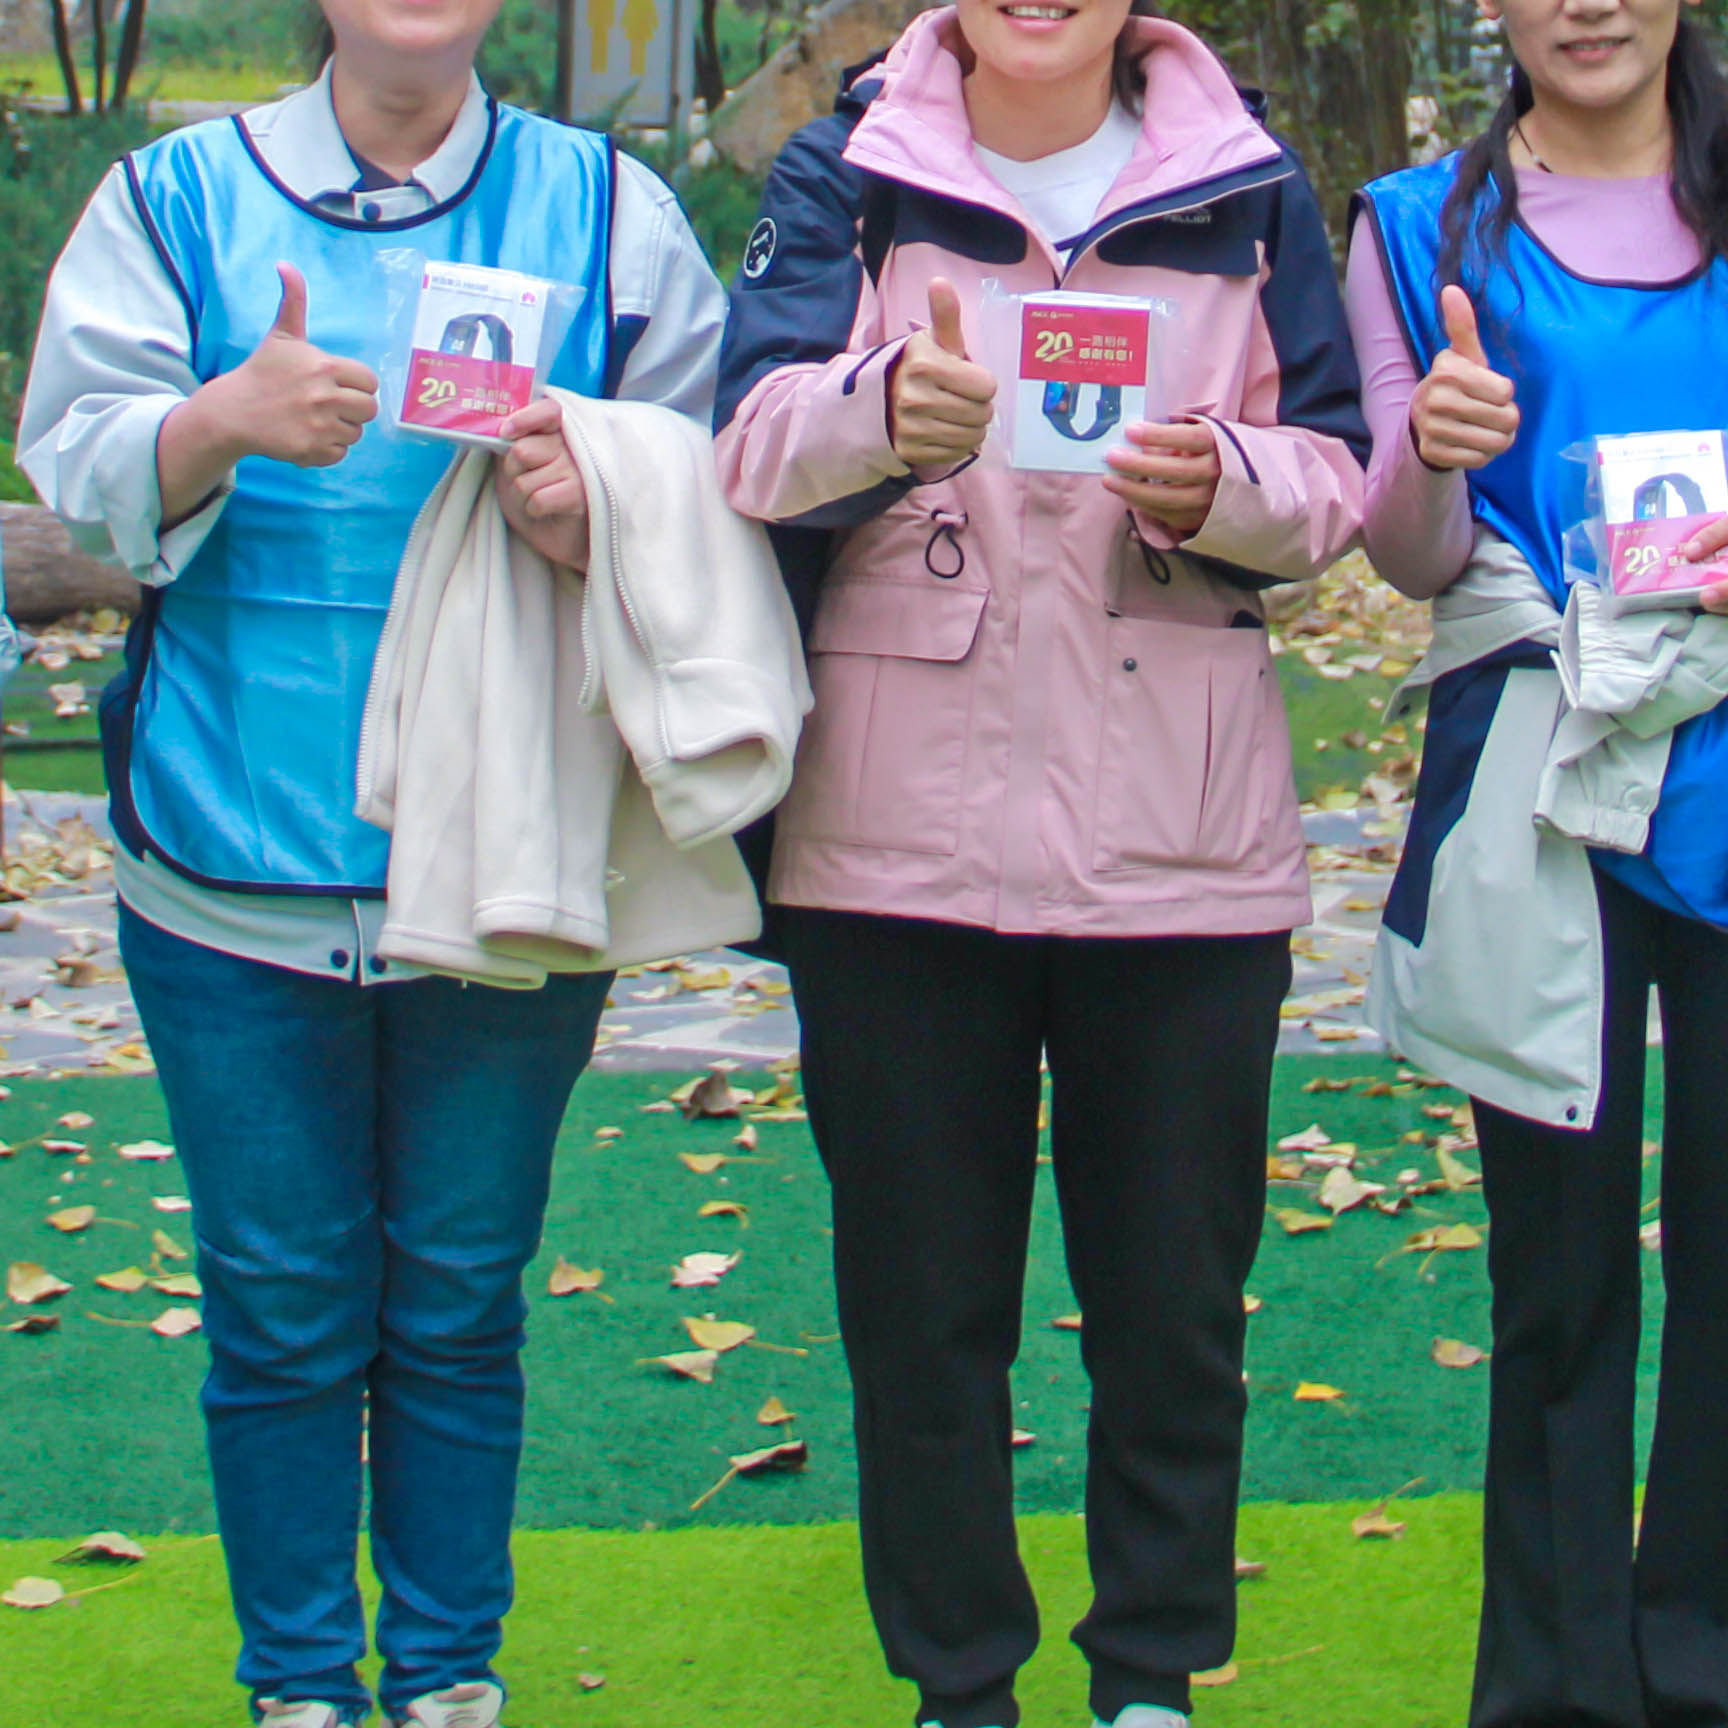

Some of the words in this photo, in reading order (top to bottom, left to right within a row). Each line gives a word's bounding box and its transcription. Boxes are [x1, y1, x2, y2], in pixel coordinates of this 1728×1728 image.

[1035, 330, 1074, 362] 20
[417, 377, 457, 408] 20
[1624, 545, 1660, 576] 20
